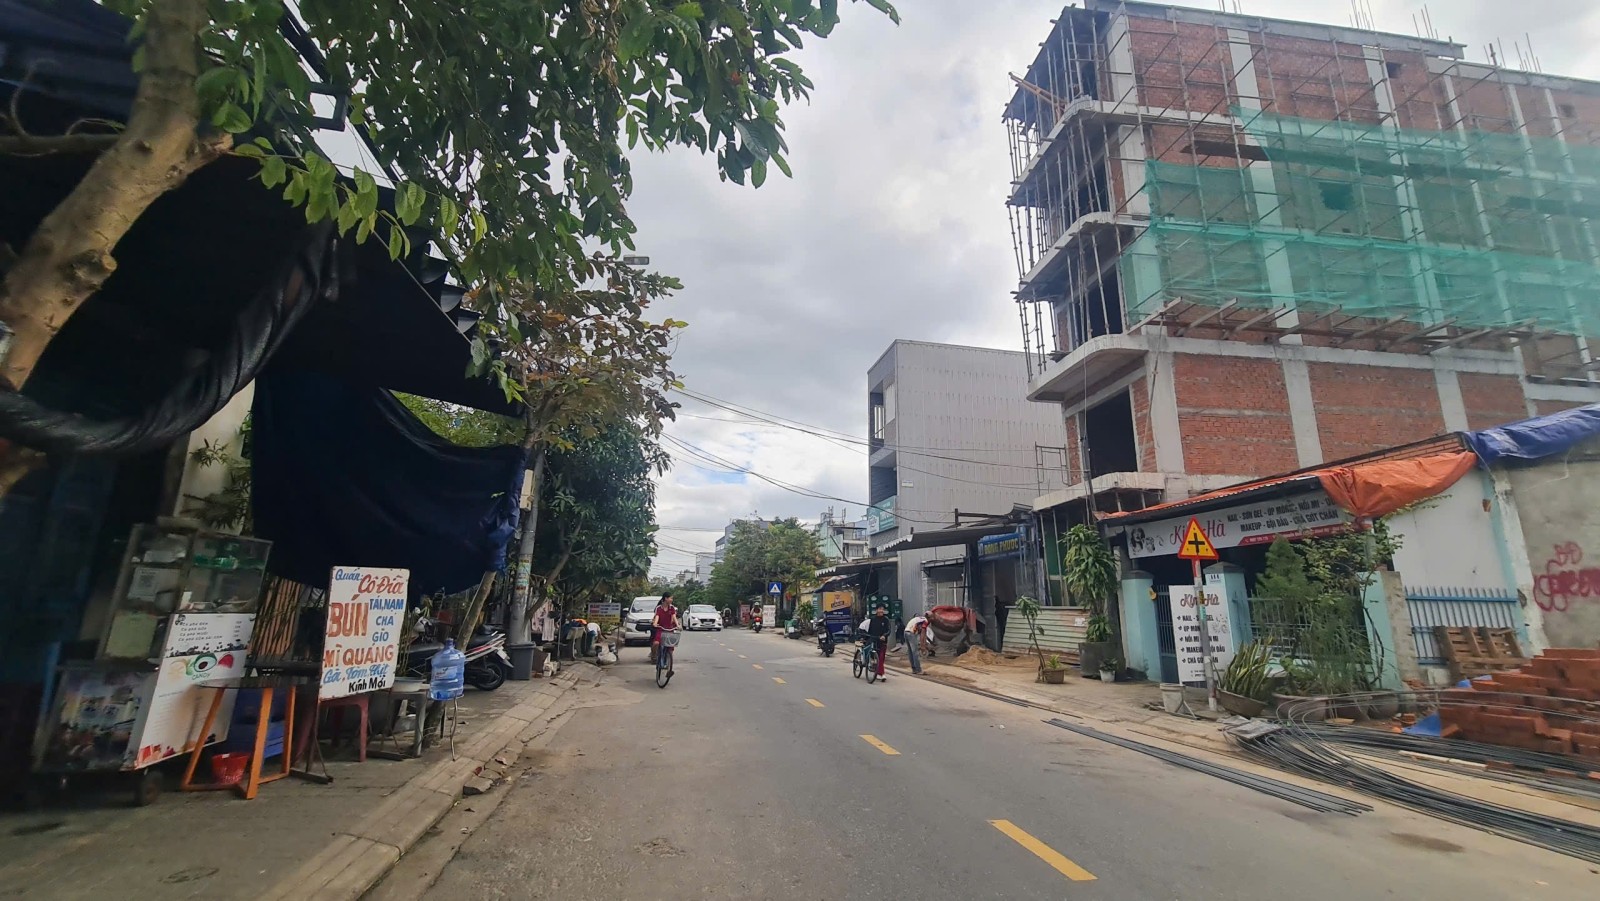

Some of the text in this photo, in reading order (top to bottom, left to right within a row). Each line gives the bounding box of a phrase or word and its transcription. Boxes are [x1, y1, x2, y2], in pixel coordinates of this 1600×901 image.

[1227, 513, 1239, 522] NAIL
[1253, 508, 1263, 518] GEL
[1240, 521, 1262, 532] MAKEUP
[328, 594, 369, 637] BÚN
